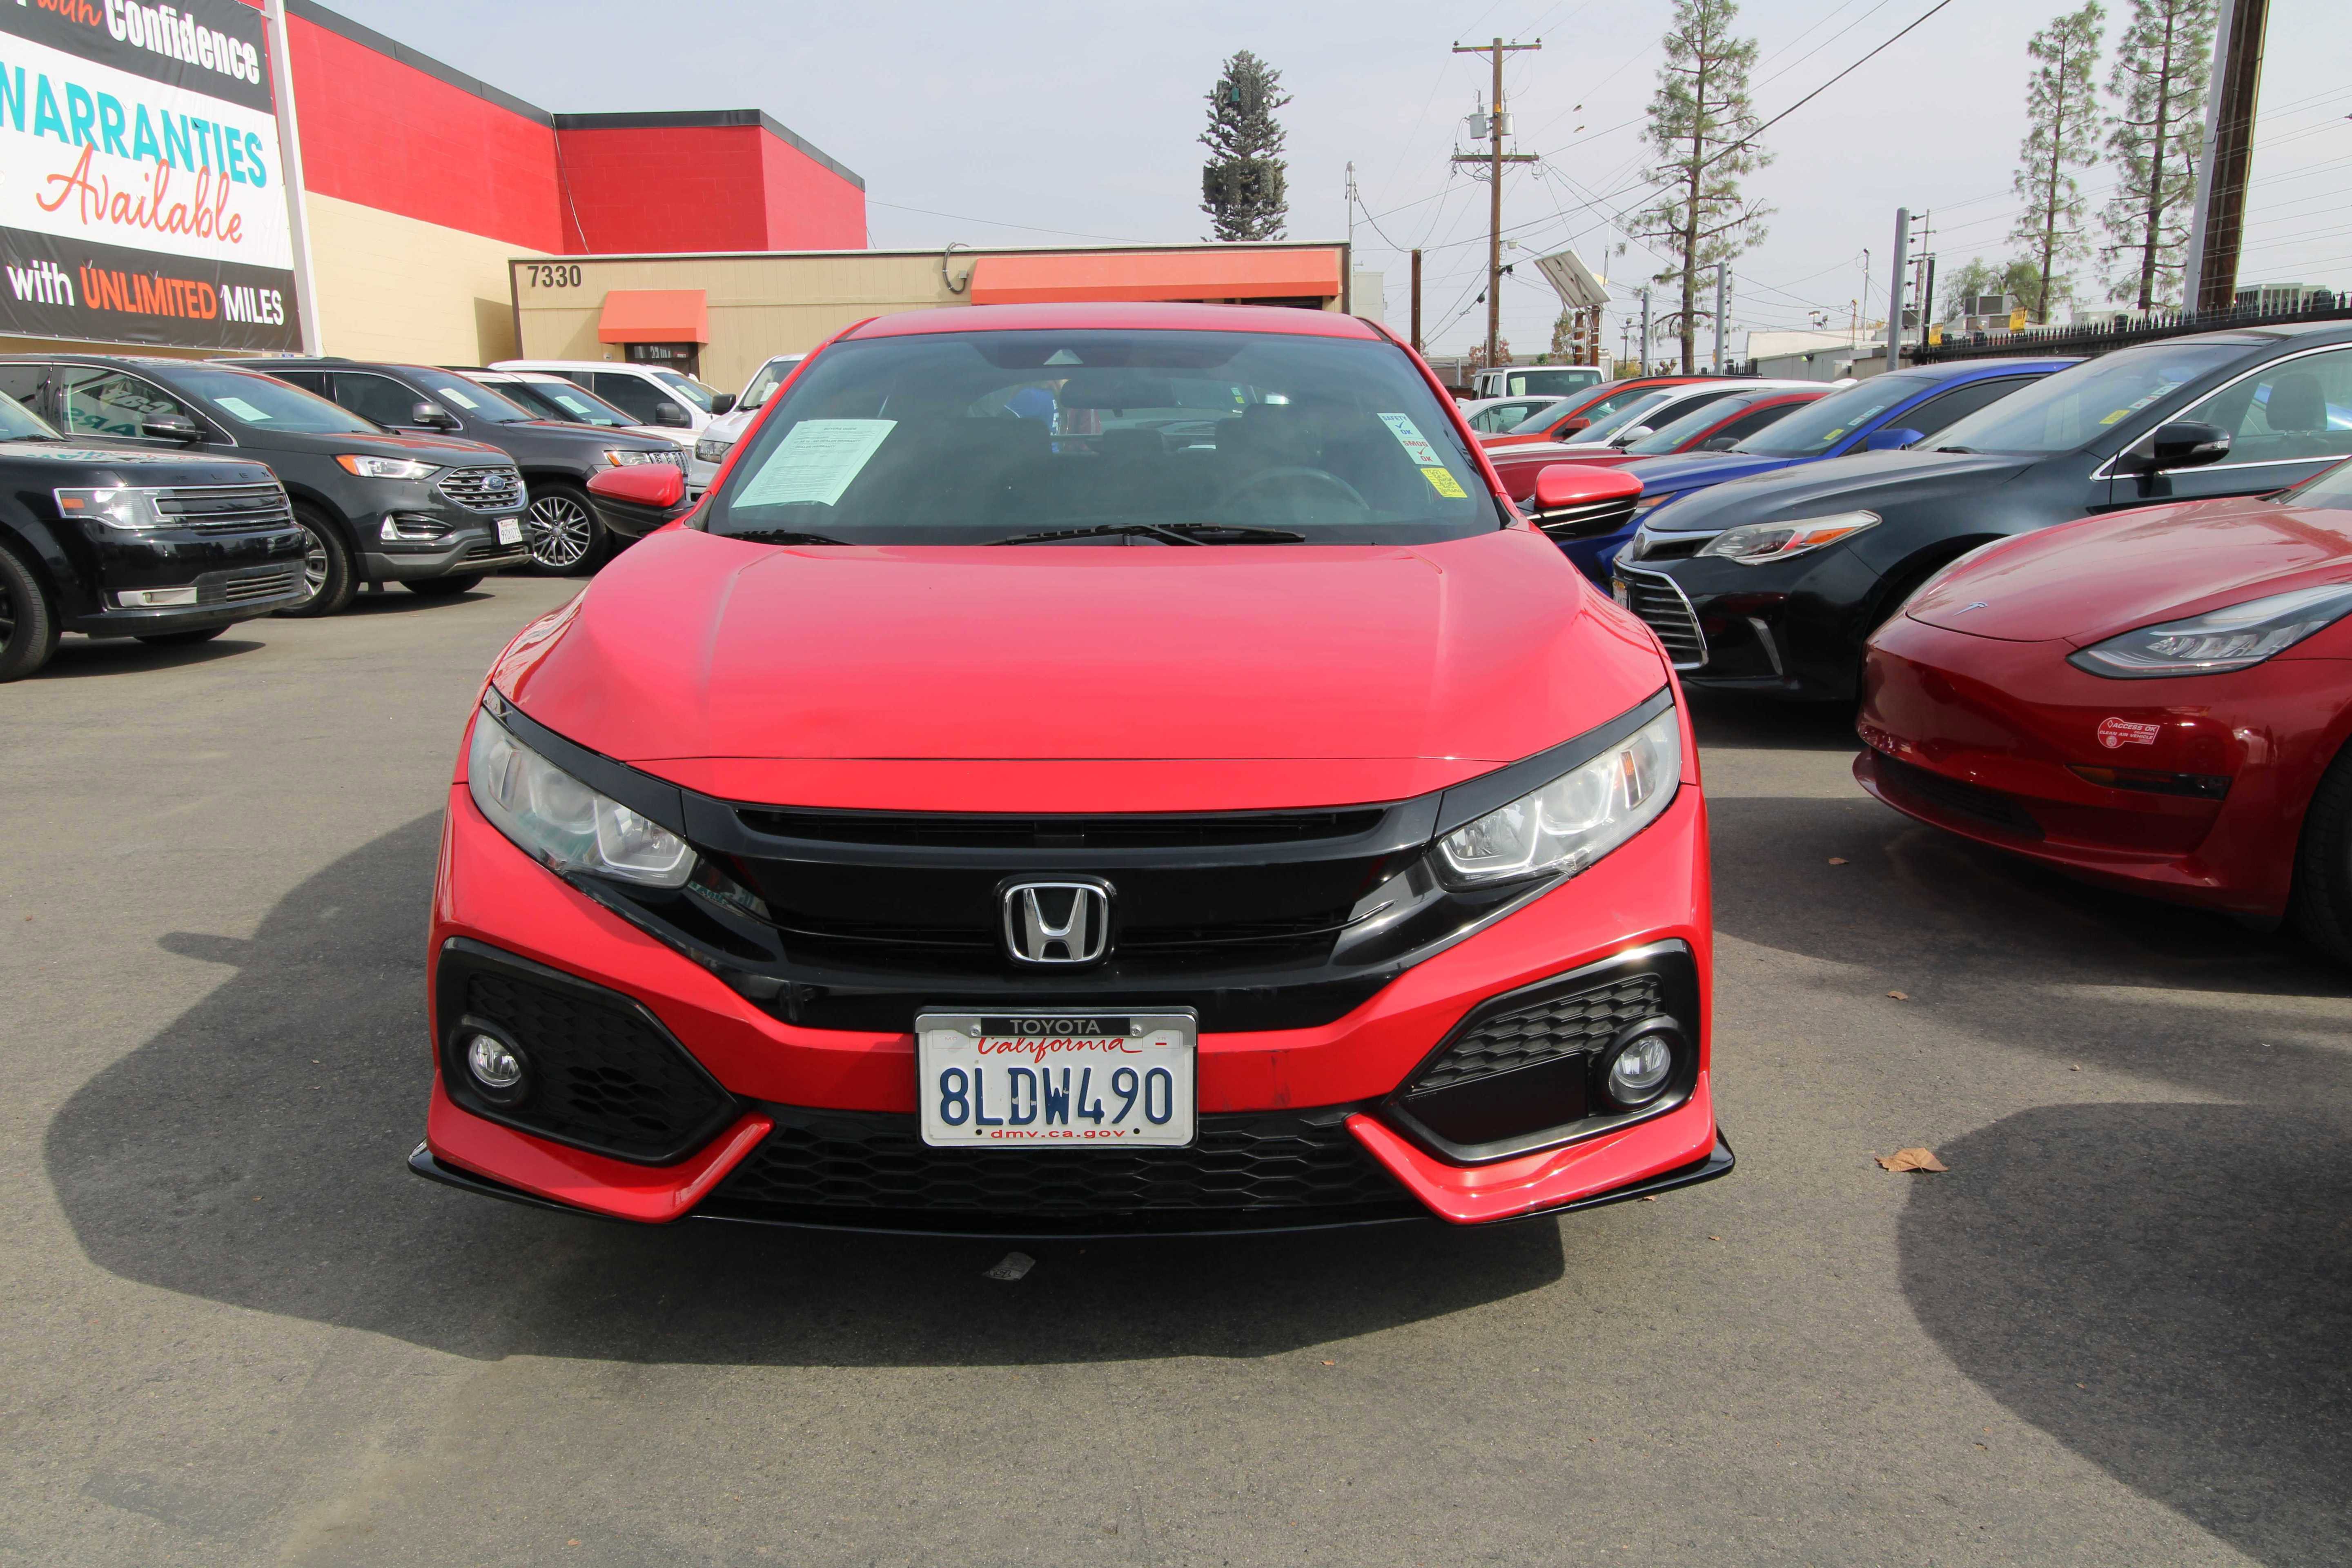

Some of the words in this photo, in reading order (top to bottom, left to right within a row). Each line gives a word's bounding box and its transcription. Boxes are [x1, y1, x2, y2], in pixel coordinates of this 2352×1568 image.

[105, 0, 260, 84] Confidence
[36, 143, 243, 244] Available
[6, 260, 75, 306] with
[80, 266, 217, 320] UNLIMITED
[222, 285, 284, 326] MILES
[528, 265, 581, 288] 7330
[1010, 1020, 1101, 1034] TOYOTA
[978, 1037, 1142, 1063] California
[940, 1067, 1173, 1126] 8LDW490
[991, 1129, 1126, 1139] dmv.ca.gov
